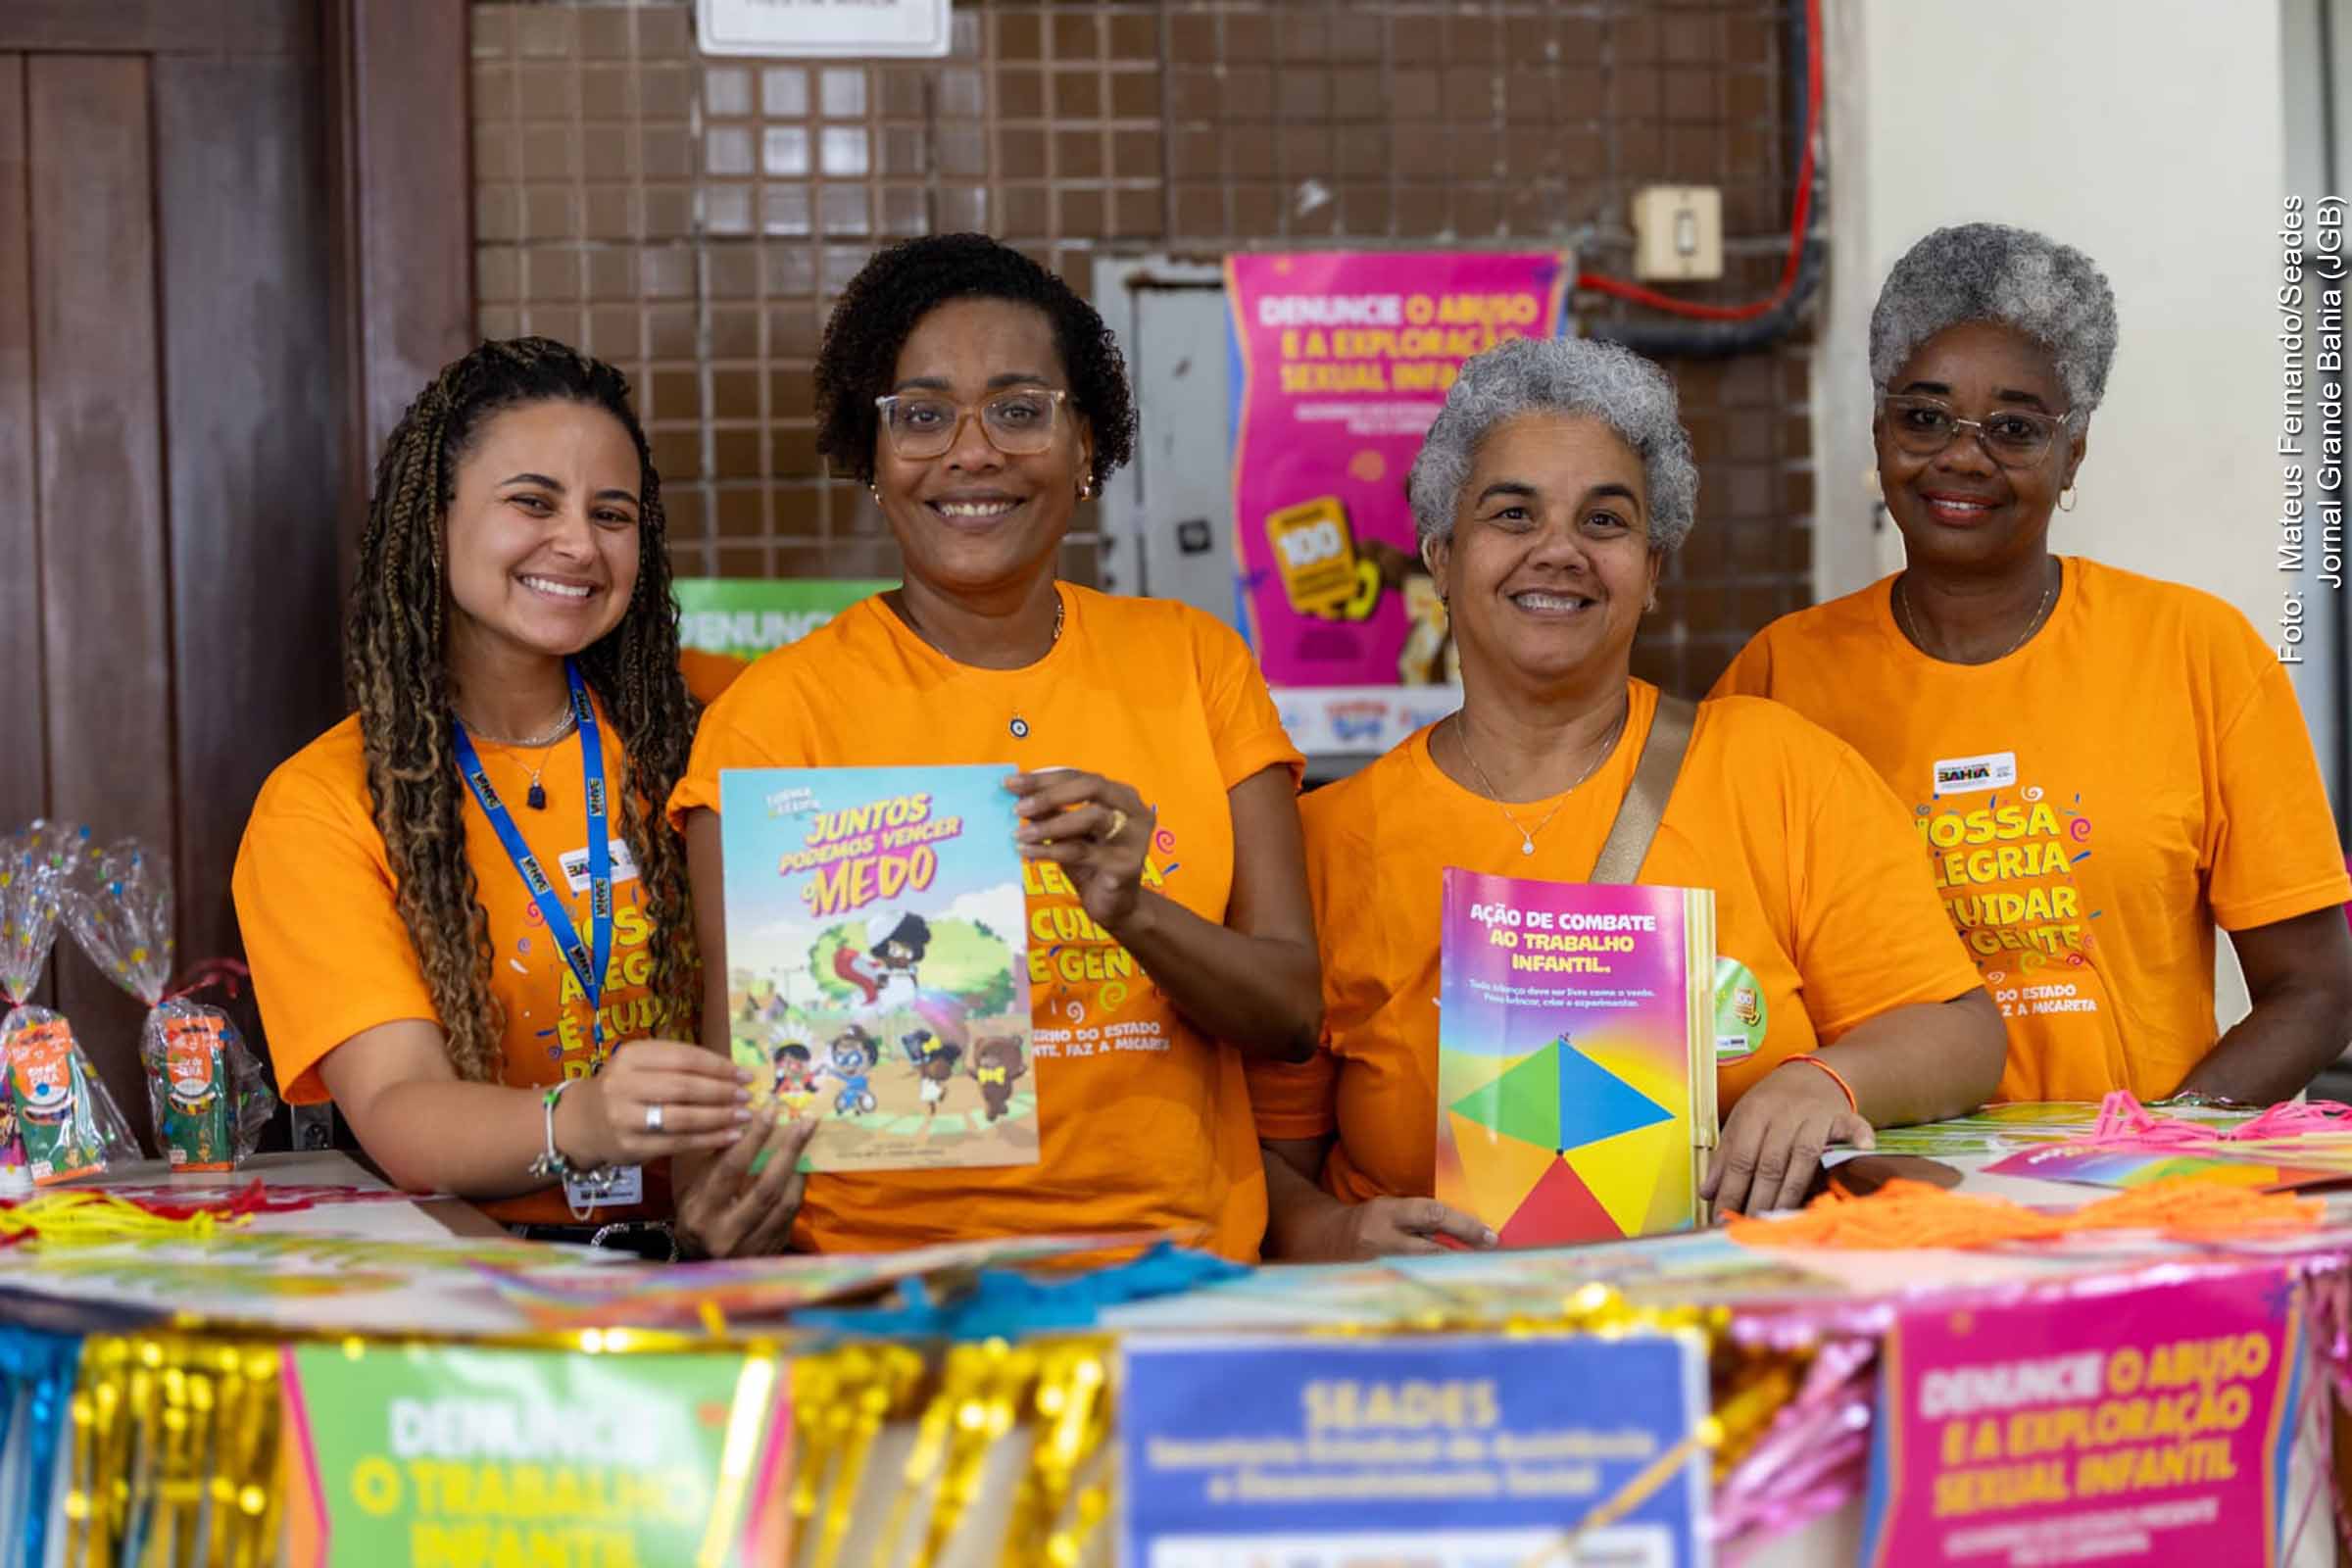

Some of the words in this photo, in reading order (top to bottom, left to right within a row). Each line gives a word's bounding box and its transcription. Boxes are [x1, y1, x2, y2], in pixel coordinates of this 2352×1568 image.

[1405, 295, 1434, 326] O
[1938, 767, 1990, 783] BAHIA
[807, 793, 932, 846] JUNTOS
[779, 834, 877, 875] PODEMOS
[883, 816, 960, 850] VENCER
[813, 846, 937, 916] MEDO
[1470, 903, 1522, 929] AÇÃO
[1526, 910, 1554, 930] DE
[1558, 912, 1656, 932] COMBATE
[1944, 886, 2079, 928] UIDAR
[1490, 928, 1518, 948] AO
[1523, 932, 1636, 953] TRABALHO
[1996, 988, 2019, 1004] DO
[2023, 983, 2078, 1001] ESTADO
[2018, 1003, 2029, 1016] A
[2032, 999, 2097, 1014] MICARETA
[1076, 1027, 1099, 1041] DO
[1104, 1021, 1160, 1038] ESTADO
[1099, 1040, 1109, 1054] A
[2107, 1348, 2143, 1393] O
[2147, 1332, 2271, 1390] ABUSO
[1304, 1381, 1499, 1430] SEADES
[1972, 1417, 2000, 1459] A
[352, 1455, 402, 1517] O
[1934, 1459, 2071, 1517] SEXUAL
[2075, 1436, 2236, 1496] INFANTIL
